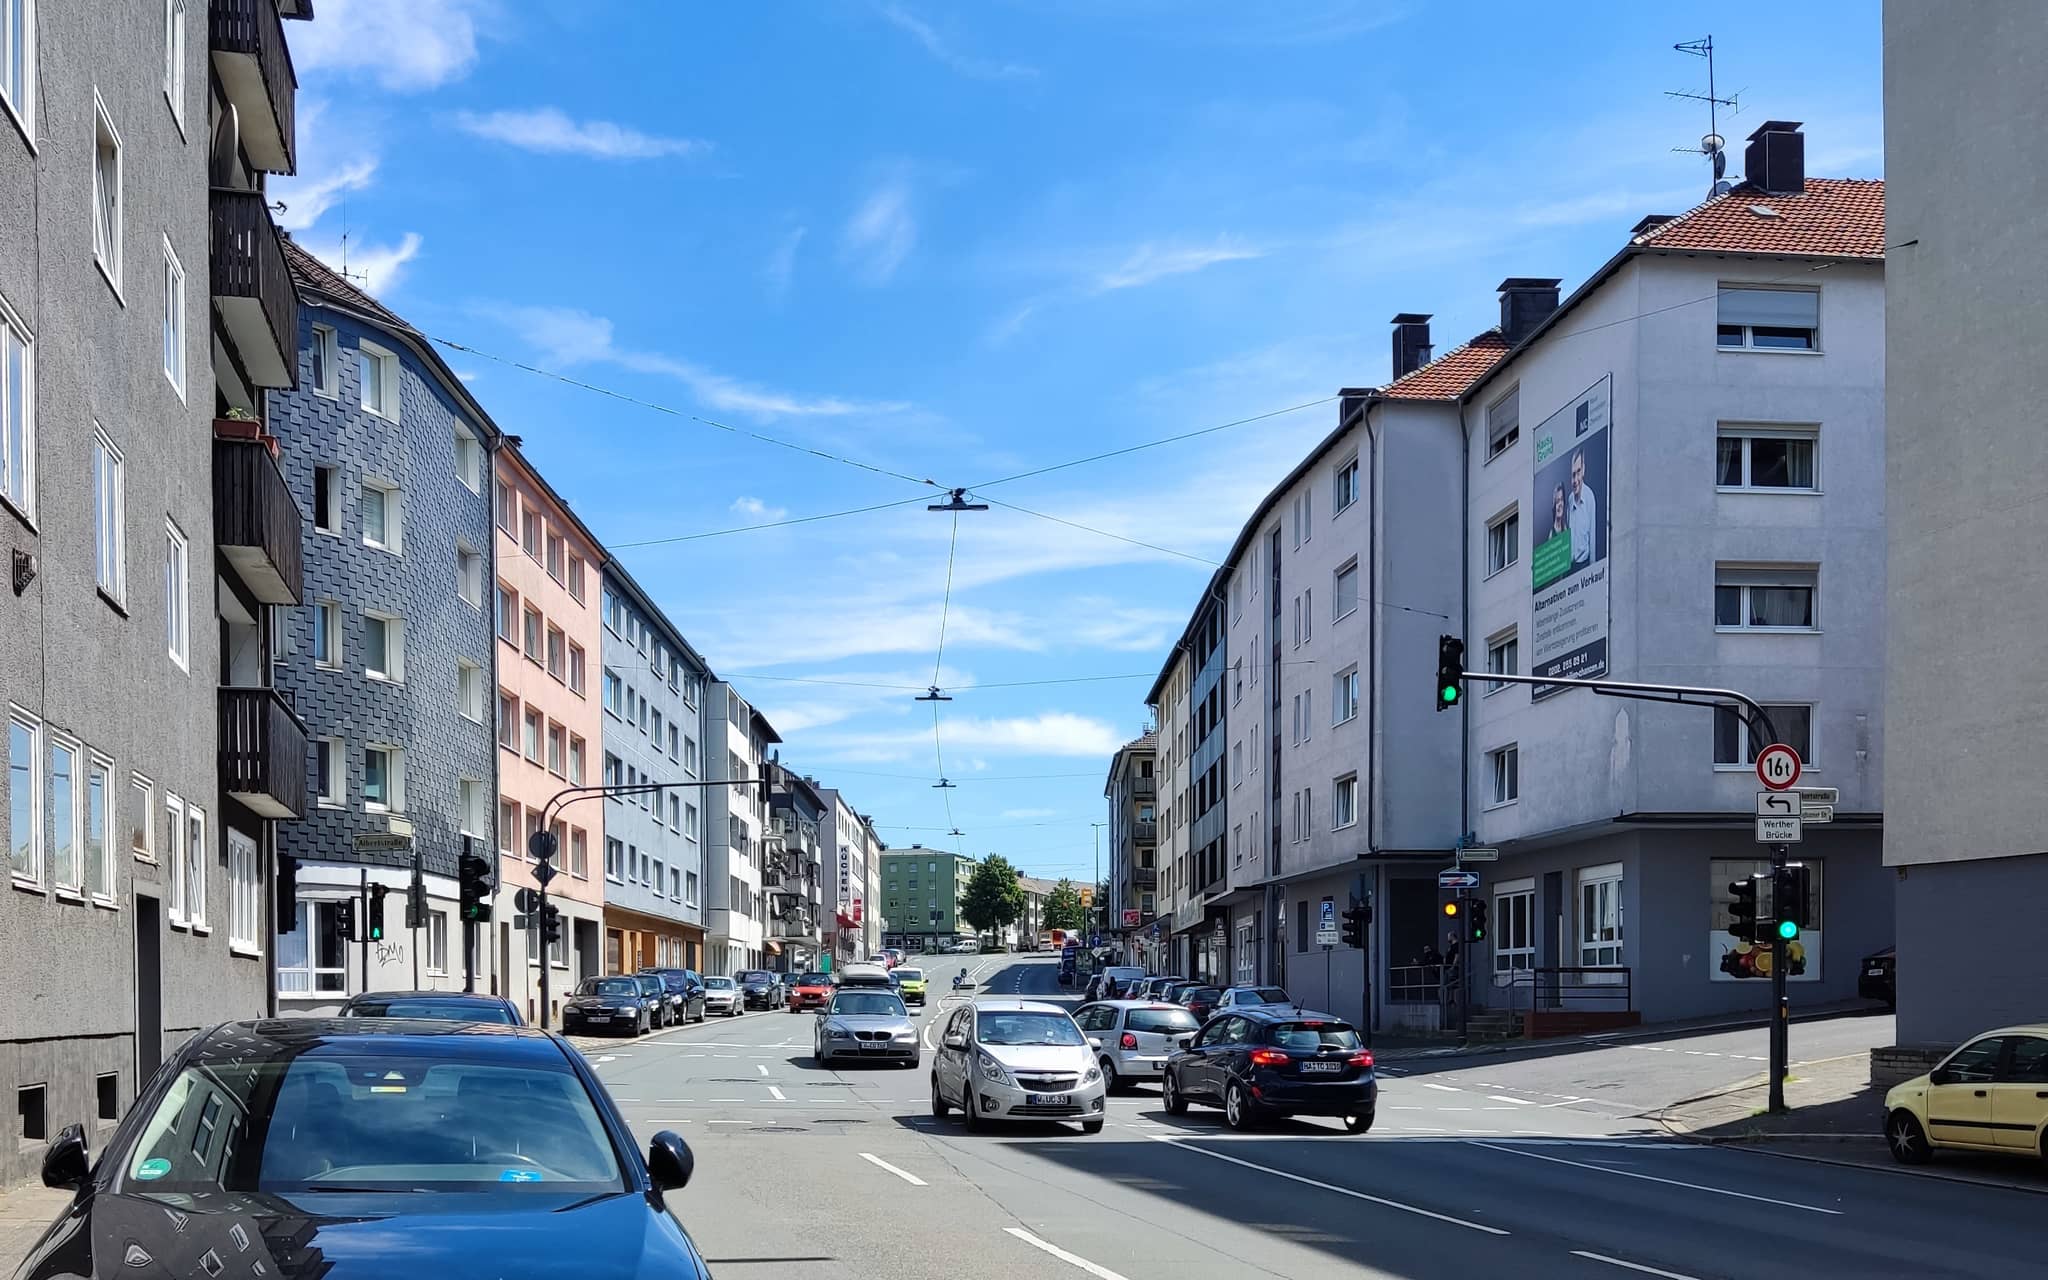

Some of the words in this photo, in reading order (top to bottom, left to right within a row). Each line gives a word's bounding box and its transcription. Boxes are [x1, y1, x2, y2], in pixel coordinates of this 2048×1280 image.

[1535, 590, 1566, 613] Alternativen
[1567, 583, 1580, 596] zum
[1580, 567, 1605, 589] Verkauf
[1763, 820, 1795, 829] Werther
[1765, 830, 1793, 840] Brücke
